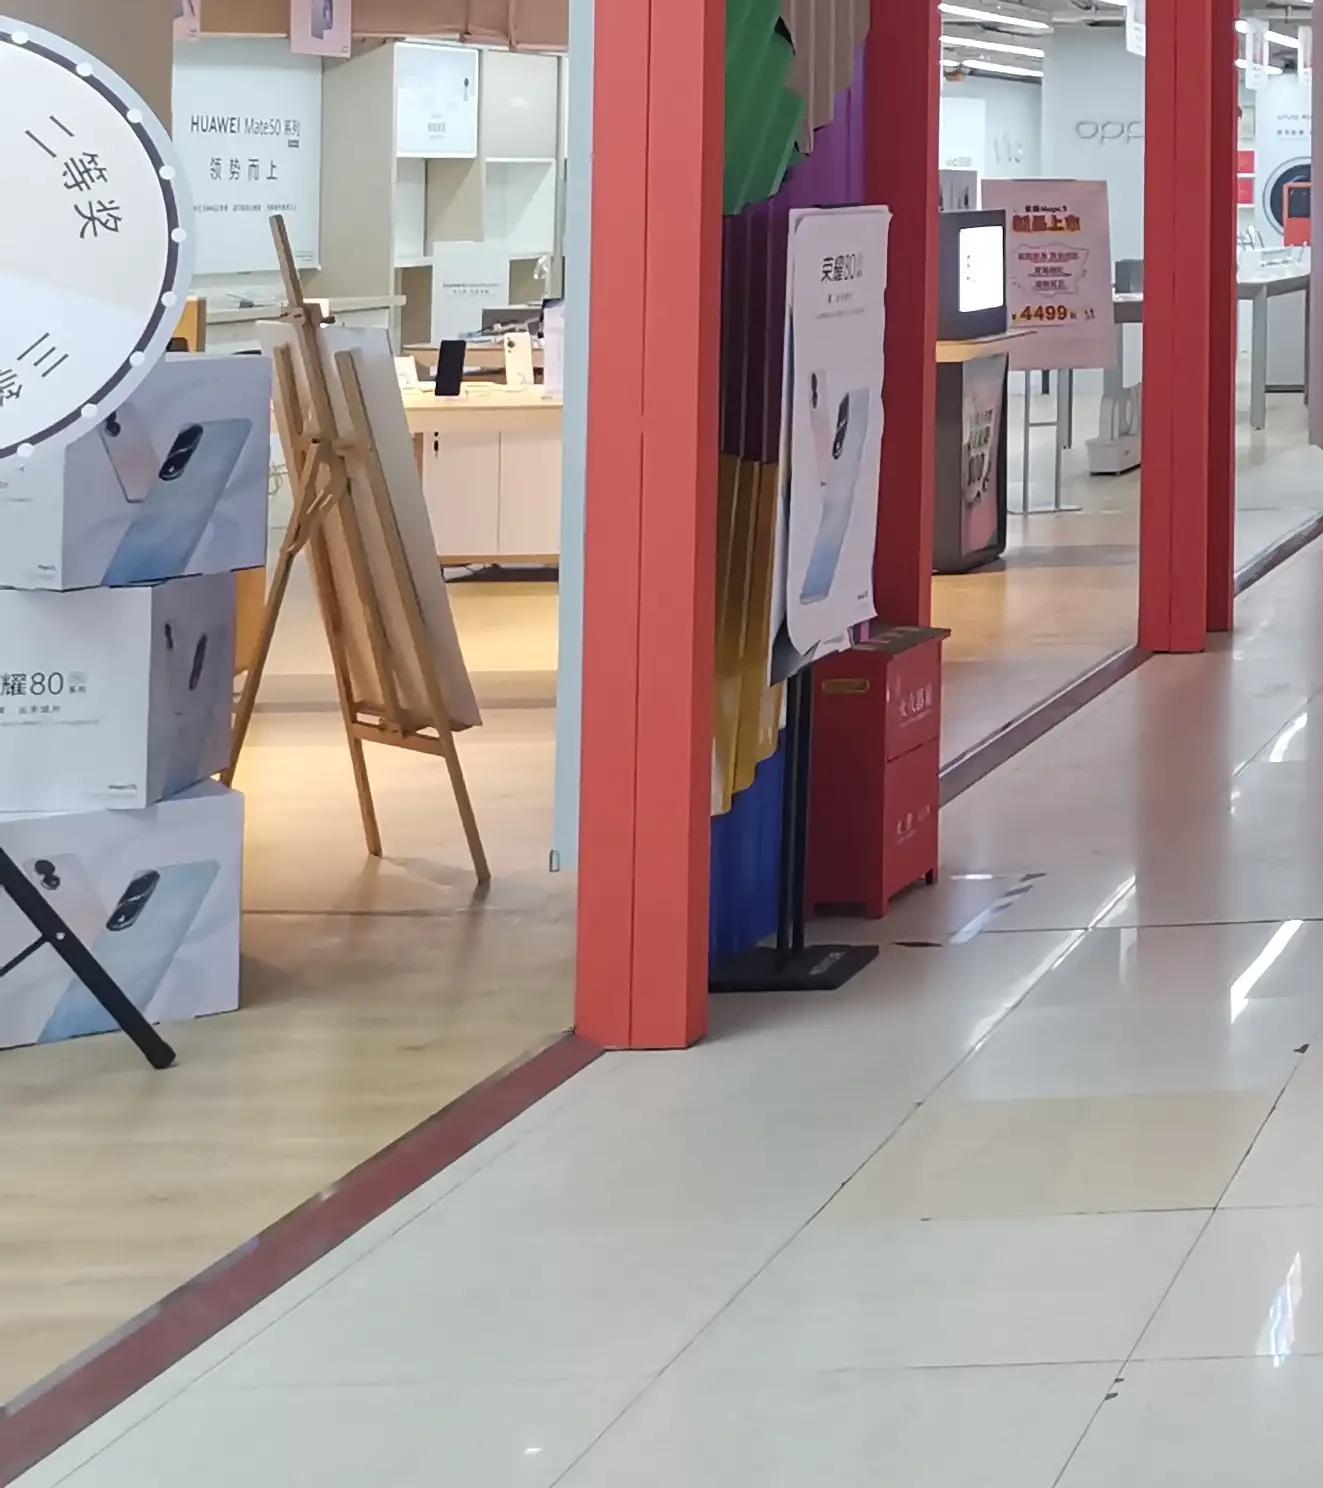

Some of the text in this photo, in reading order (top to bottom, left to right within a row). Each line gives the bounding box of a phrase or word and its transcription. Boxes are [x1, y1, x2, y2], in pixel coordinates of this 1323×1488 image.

[191, 115, 240, 133] HUAWEI
[244, 118, 282, 136] Mate50
[25, 114, 122, 239] 二等奖
[209, 157, 278, 180] 领势而上
[1020, 305, 1068, 321] 4499
